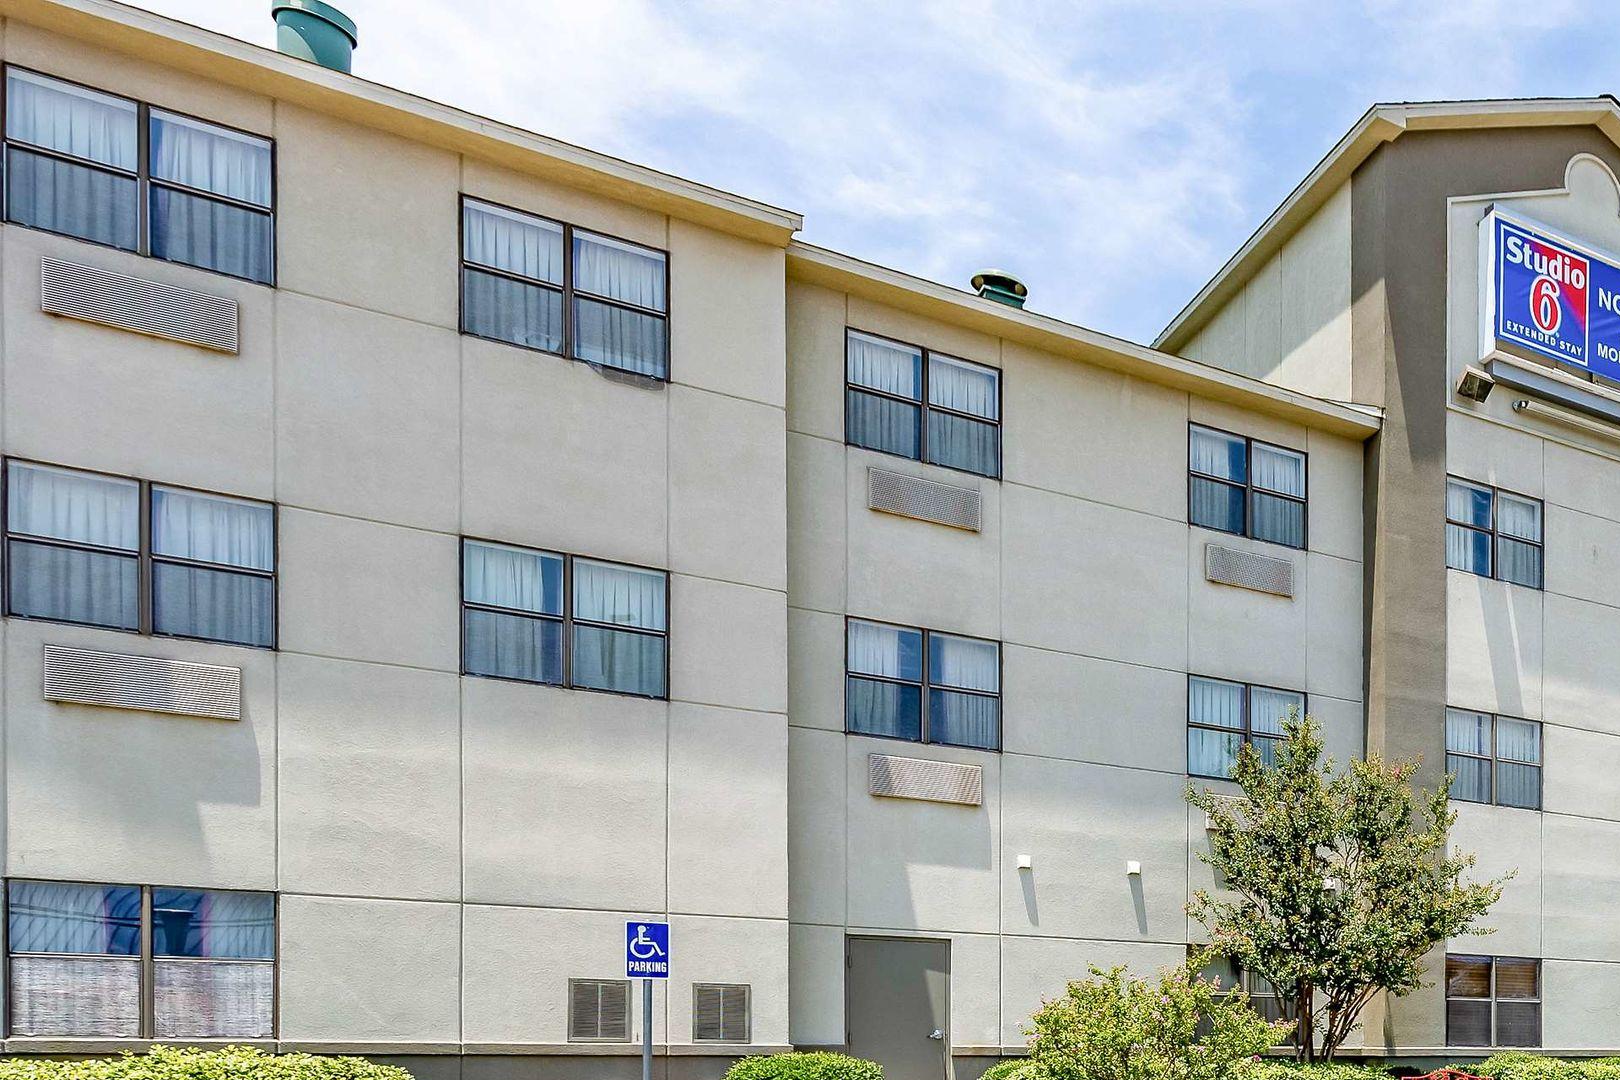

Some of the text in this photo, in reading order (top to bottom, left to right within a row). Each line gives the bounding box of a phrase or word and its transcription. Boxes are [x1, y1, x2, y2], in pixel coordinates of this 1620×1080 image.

[1506, 236, 1585, 290] Studio
[1529, 274, 1562, 335] 6
[1506, 320, 1583, 356] EXTENDED STAY
[628, 961, 667, 973] PARKING
